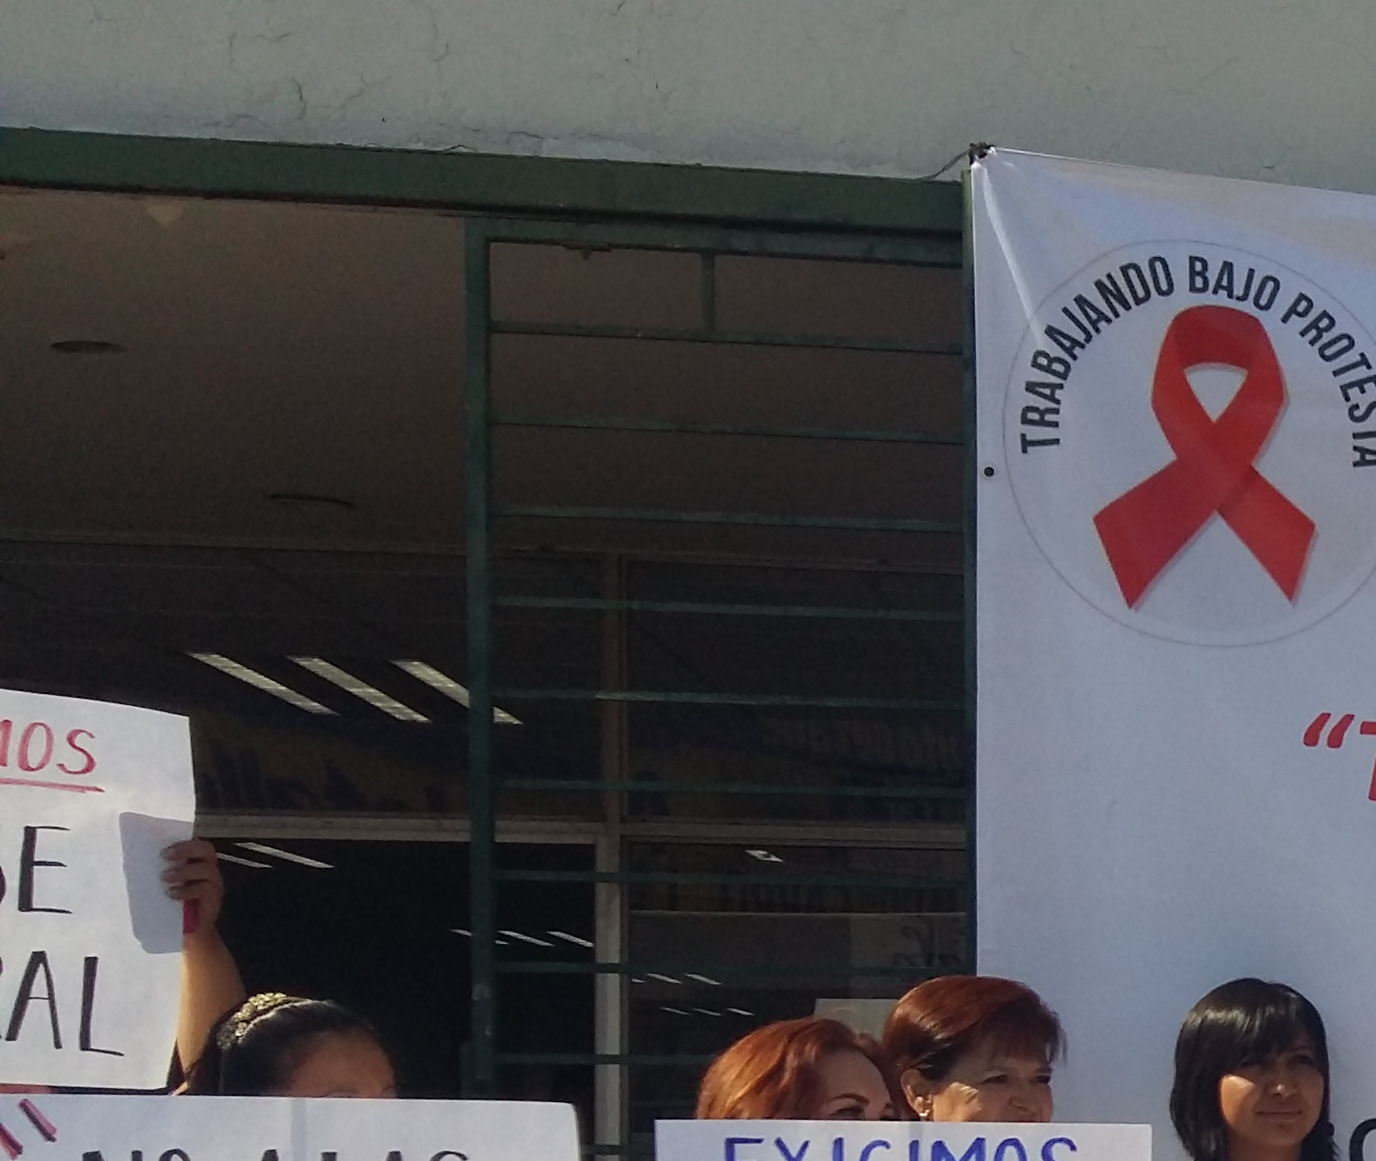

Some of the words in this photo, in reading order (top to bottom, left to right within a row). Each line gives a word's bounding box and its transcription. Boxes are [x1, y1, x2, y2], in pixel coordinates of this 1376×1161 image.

[1020, 255, 1174, 453] TRABAJANDO
[1188, 255, 1281, 311] BAJO
[0, 951, 125, 1057] AL
